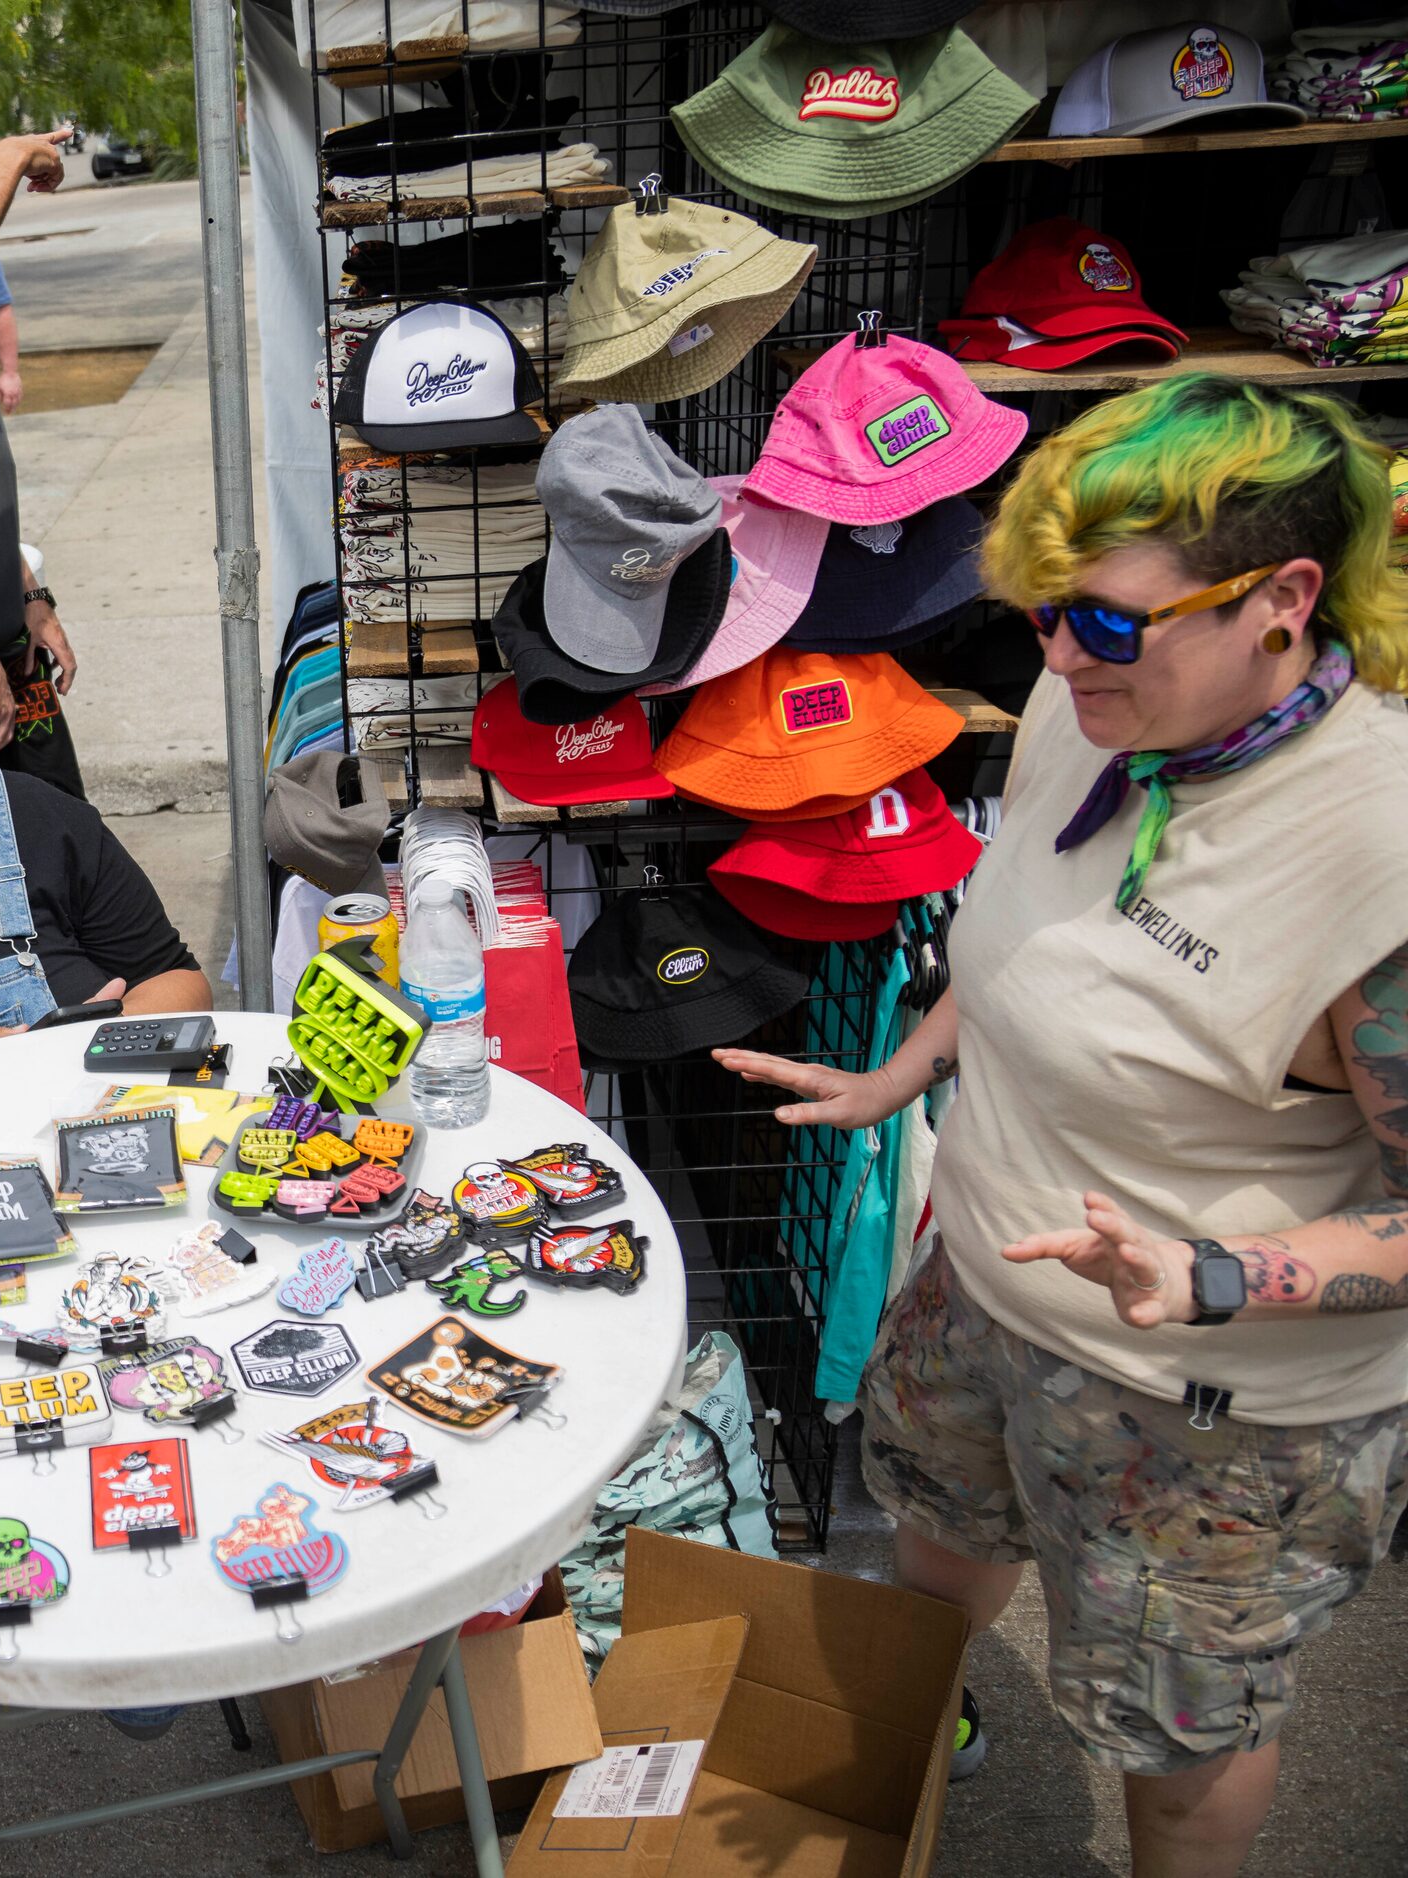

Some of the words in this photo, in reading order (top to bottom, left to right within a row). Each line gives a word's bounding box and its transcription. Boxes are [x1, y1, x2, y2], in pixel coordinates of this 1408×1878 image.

[804, 71, 896, 101] Dallas
[407, 362, 447, 407] Deep
[447, 354, 487, 381] Ellum
[441, 384, 468, 396] TEXAS
[879, 405, 930, 444] deep
[887, 418, 940, 456] ellum
[790, 686, 841, 713] DEEP
[793, 705, 845, 728] ELLUM
[556, 723, 592, 762] Deep
[592, 715, 625, 739] Ellum
[586, 741, 611, 754] TEXAS
[865, 787, 910, 840] D
[665, 958, 704, 979] Ellum
[685, 953, 702, 963] DEEP
[313, 968, 401, 1037] DEEP
[301, 983, 399, 1066] ELLUM
[296, 1022, 375, 1095] TEXAS
[296, 1103, 317, 1134] TEXAS
[475, 1191, 533, 1219] ELLUM
[476, 1181, 519, 1205] DEEP
[281, 1282, 324, 1312] Deep
[310, 1255, 349, 1282] Ellum
[249, 1366, 293, 1385] DEEP
[294, 1352, 351, 1377] ELLUM
[303, 1370, 337, 1389] 1873
[306, 1409, 364, 1435] テキサス
[717, 1405, 736, 1434] 100%
[354, 1488, 385, 1504] DEEP
[103, 1503, 175, 1522] deep
[232, 1556, 274, 1582] DEEP
